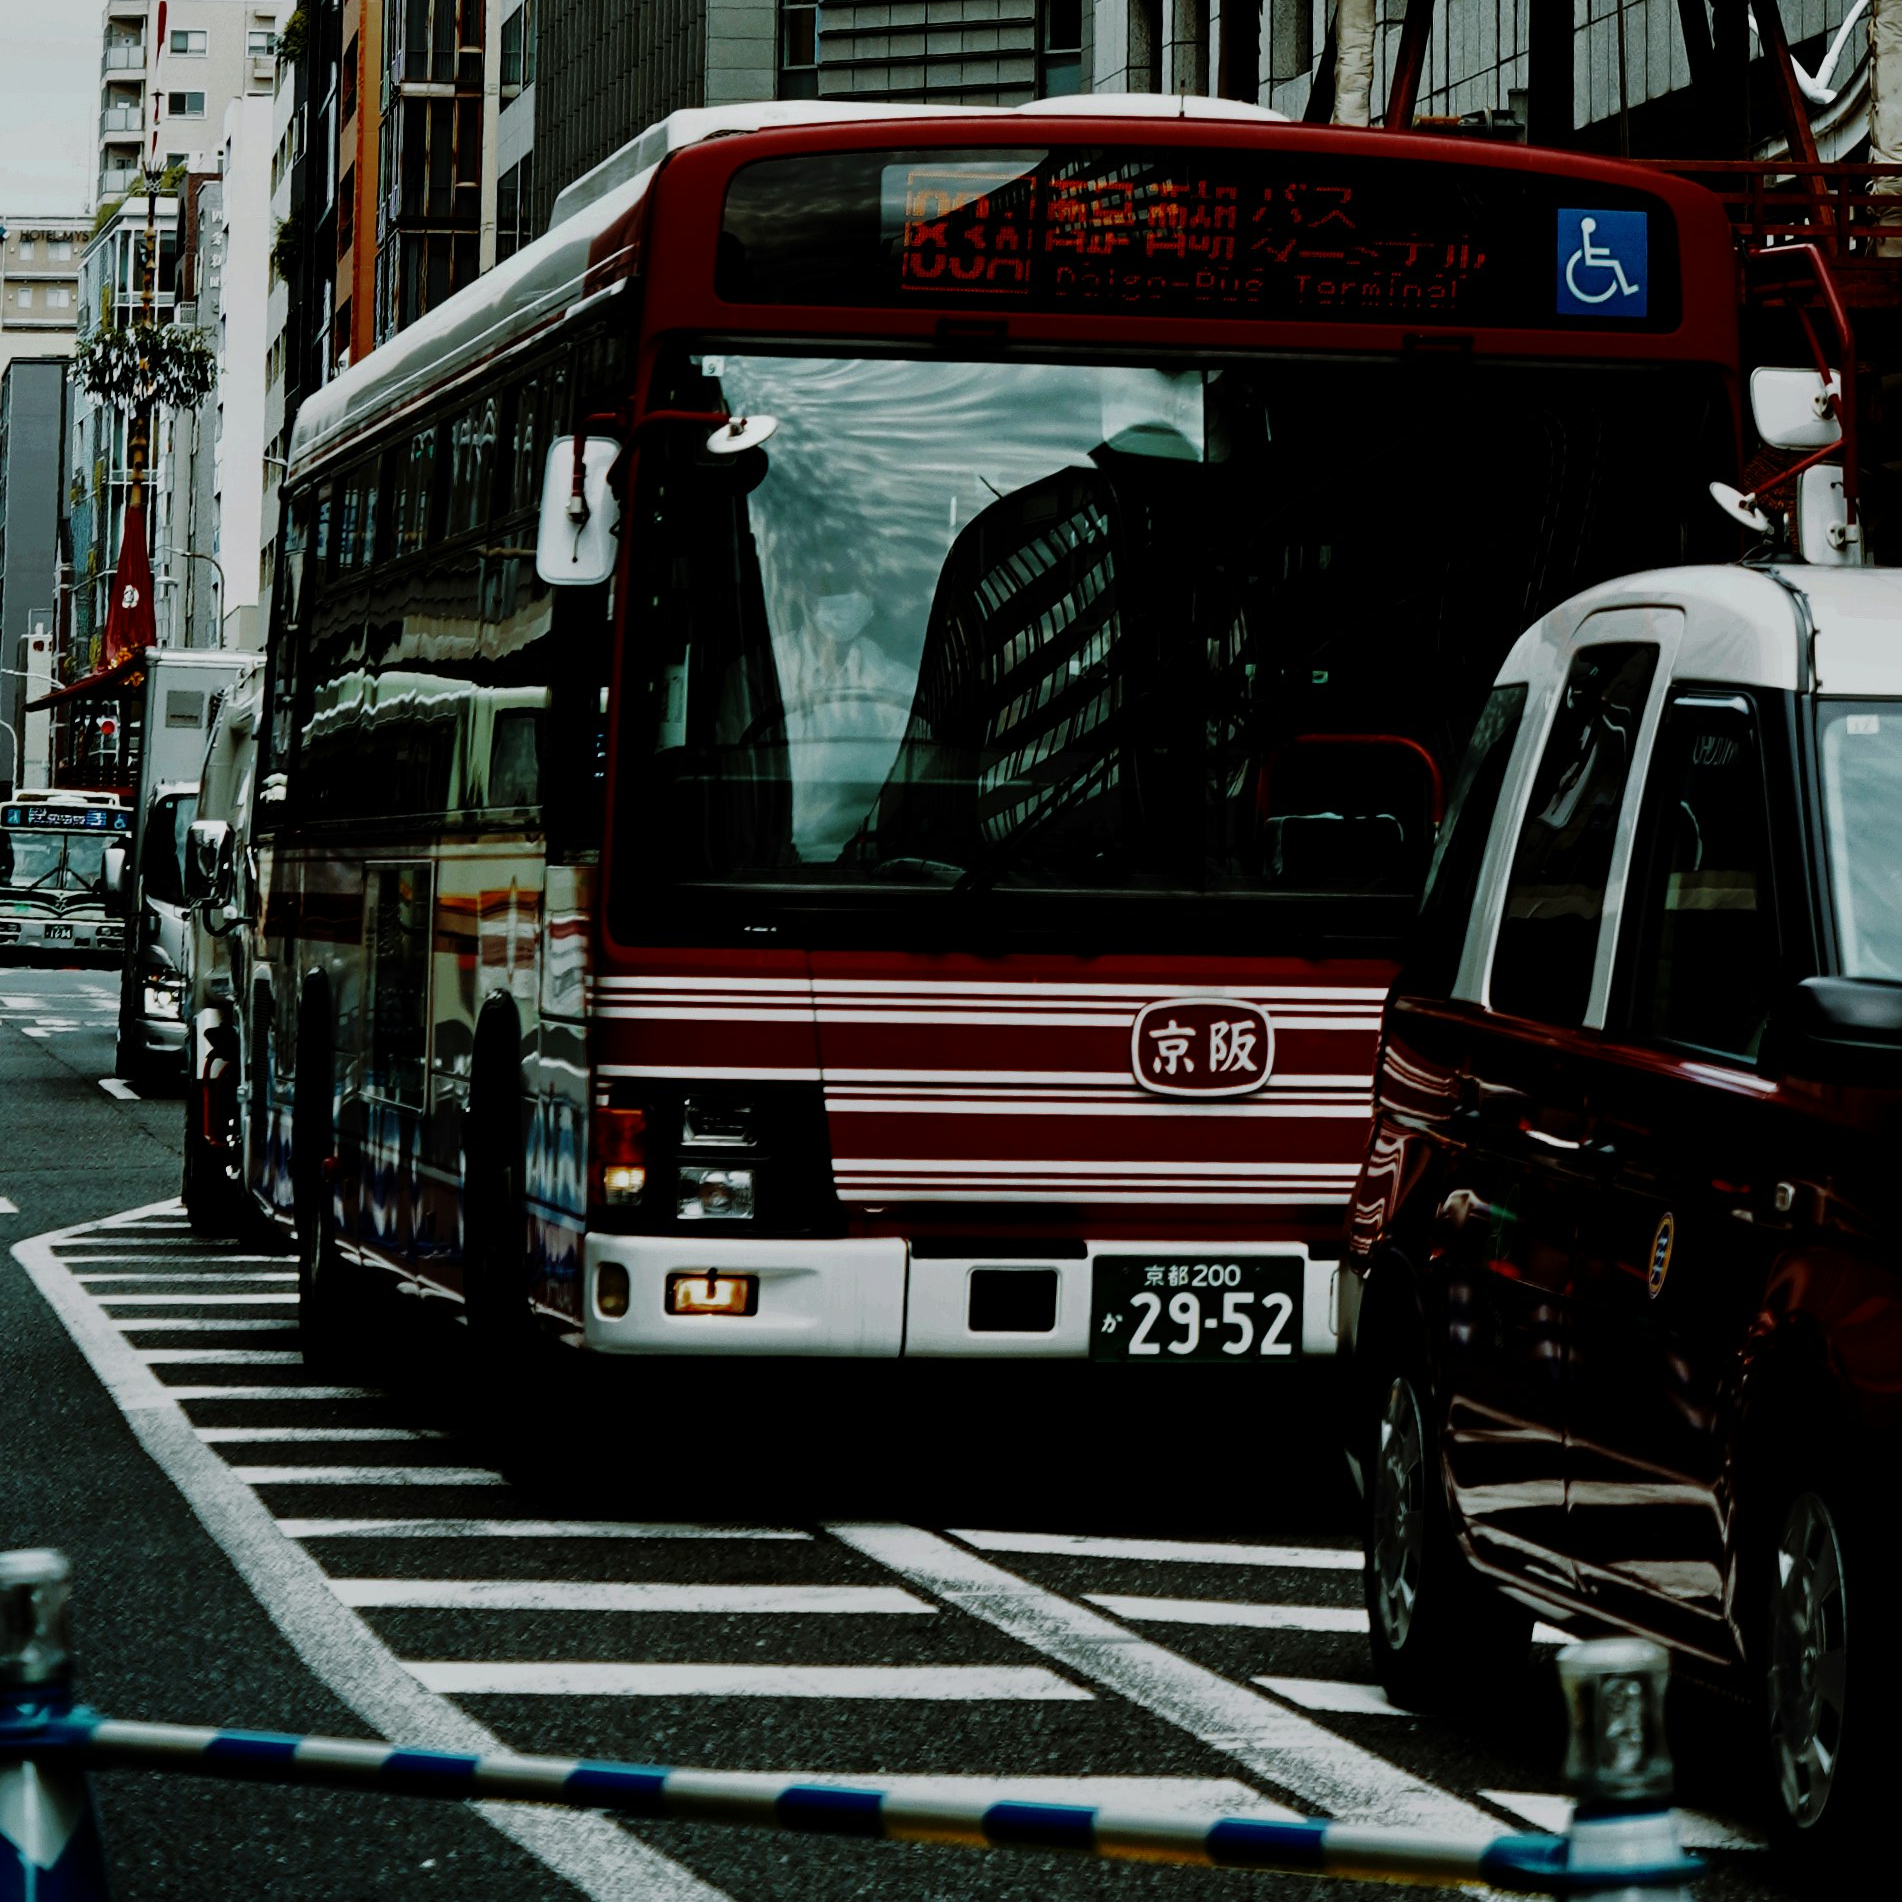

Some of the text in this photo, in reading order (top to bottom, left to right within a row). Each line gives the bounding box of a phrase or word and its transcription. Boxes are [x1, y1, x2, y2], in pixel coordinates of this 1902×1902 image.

[20, 230, 60, 242] HOTEL
[1148, 1017, 1259, 1075] 京阪
[1143, 1262, 1242, 1289] 京都200
[1127, 1290, 1296, 1358] 29-52
